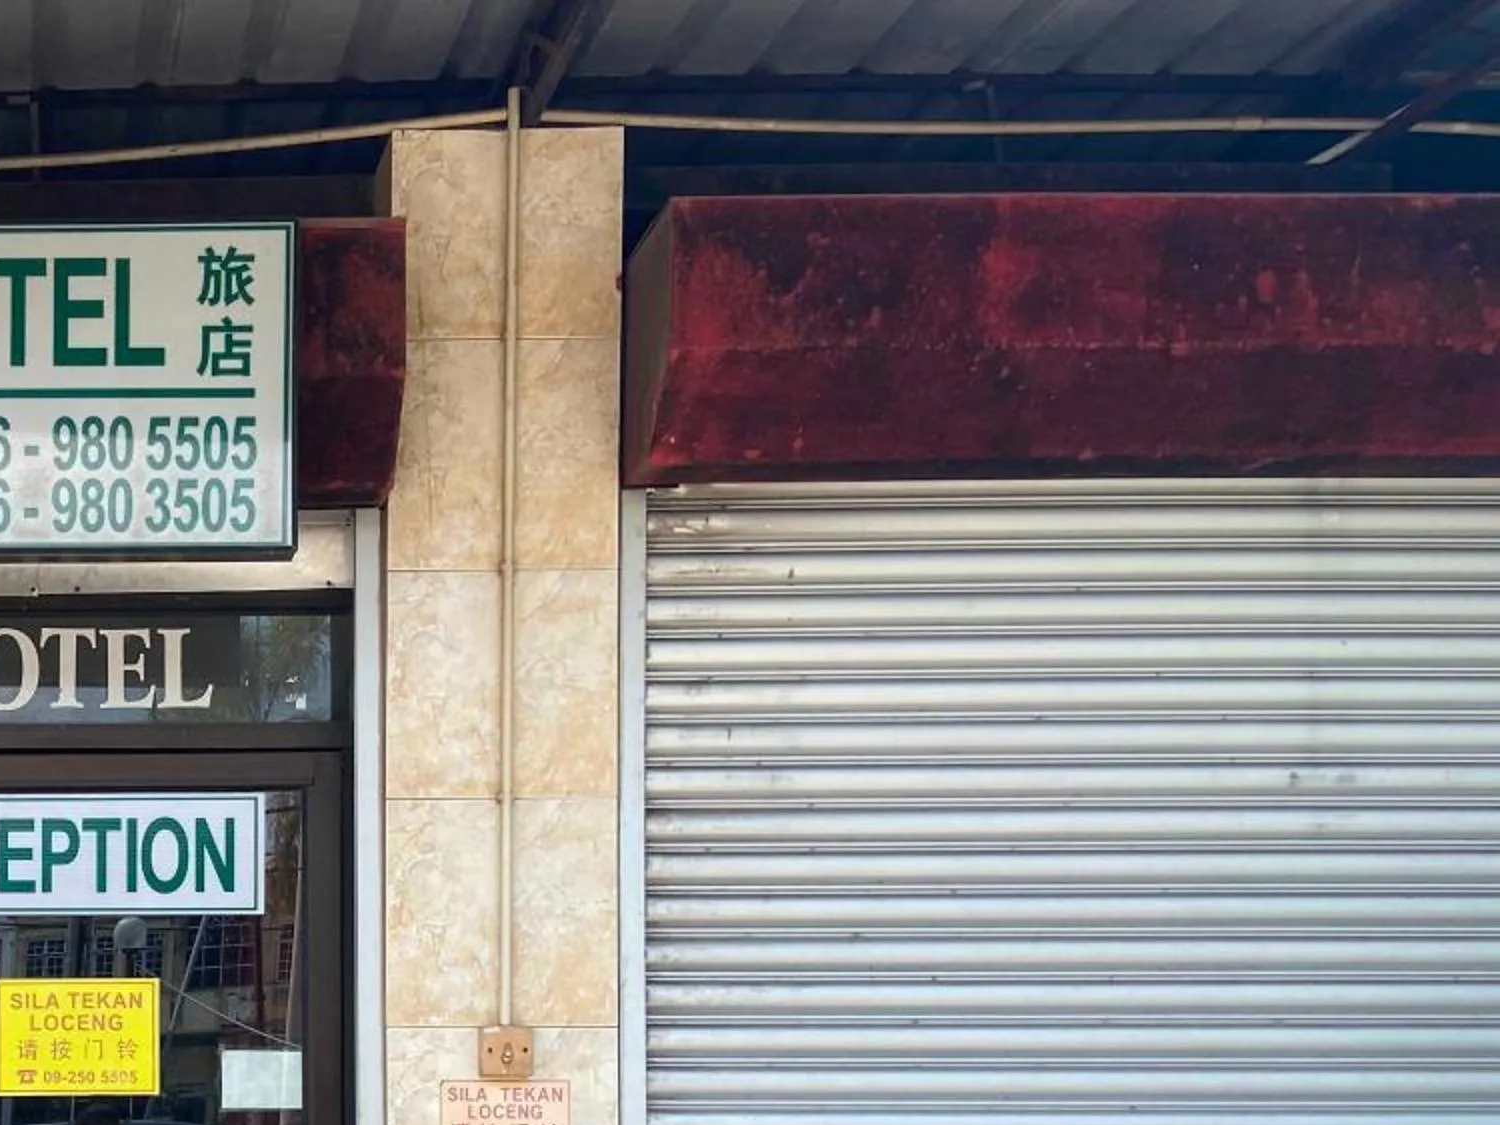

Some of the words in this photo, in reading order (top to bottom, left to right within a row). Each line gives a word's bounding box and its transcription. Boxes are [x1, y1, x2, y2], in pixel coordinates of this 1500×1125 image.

[196, 245, 256, 377] 旅店
[52, 415, 134, 470] 980
[145, 415, 257, 470] 5505
[51, 479, 133, 533] 980
[145, 478, 256, 533] 3505
[10, 992, 60, 1010] SILA
[67, 991, 143, 1010] TEKAN
[29, 1014, 124, 1031] LOCENG
[447, 1086, 488, 1102] SILA
[500, 1086, 564, 1103] TEKAN
[467, 1103, 544, 1120] LOCENG
